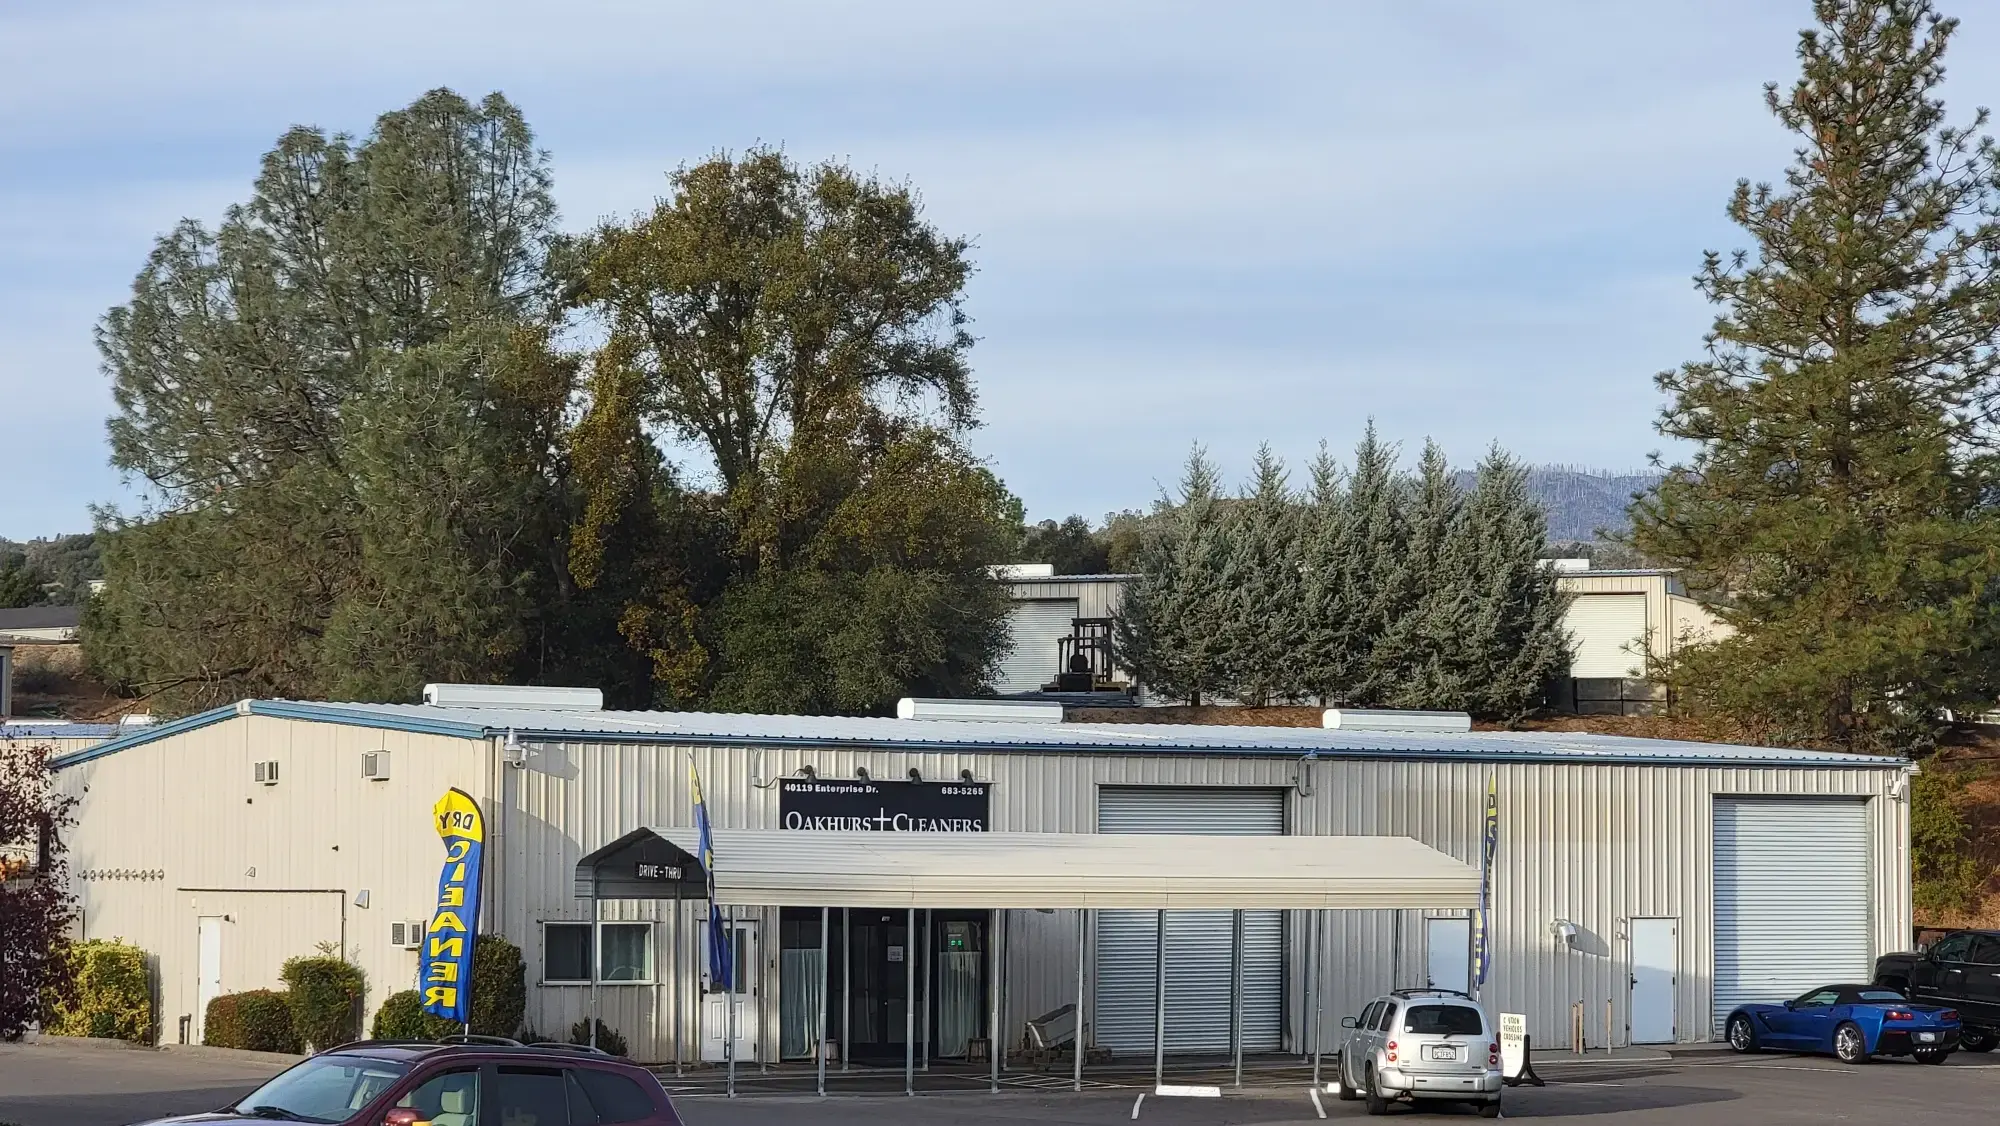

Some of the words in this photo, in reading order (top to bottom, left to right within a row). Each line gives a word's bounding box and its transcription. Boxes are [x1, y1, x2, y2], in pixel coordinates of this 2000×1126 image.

[785, 783, 813, 792] 40119
[815, 784, 863, 794] Enterprise
[865, 785, 879, 793] Dr.
[941, 786, 984, 795] 683-5265
[892, 813, 982, 832] CLEANERS
